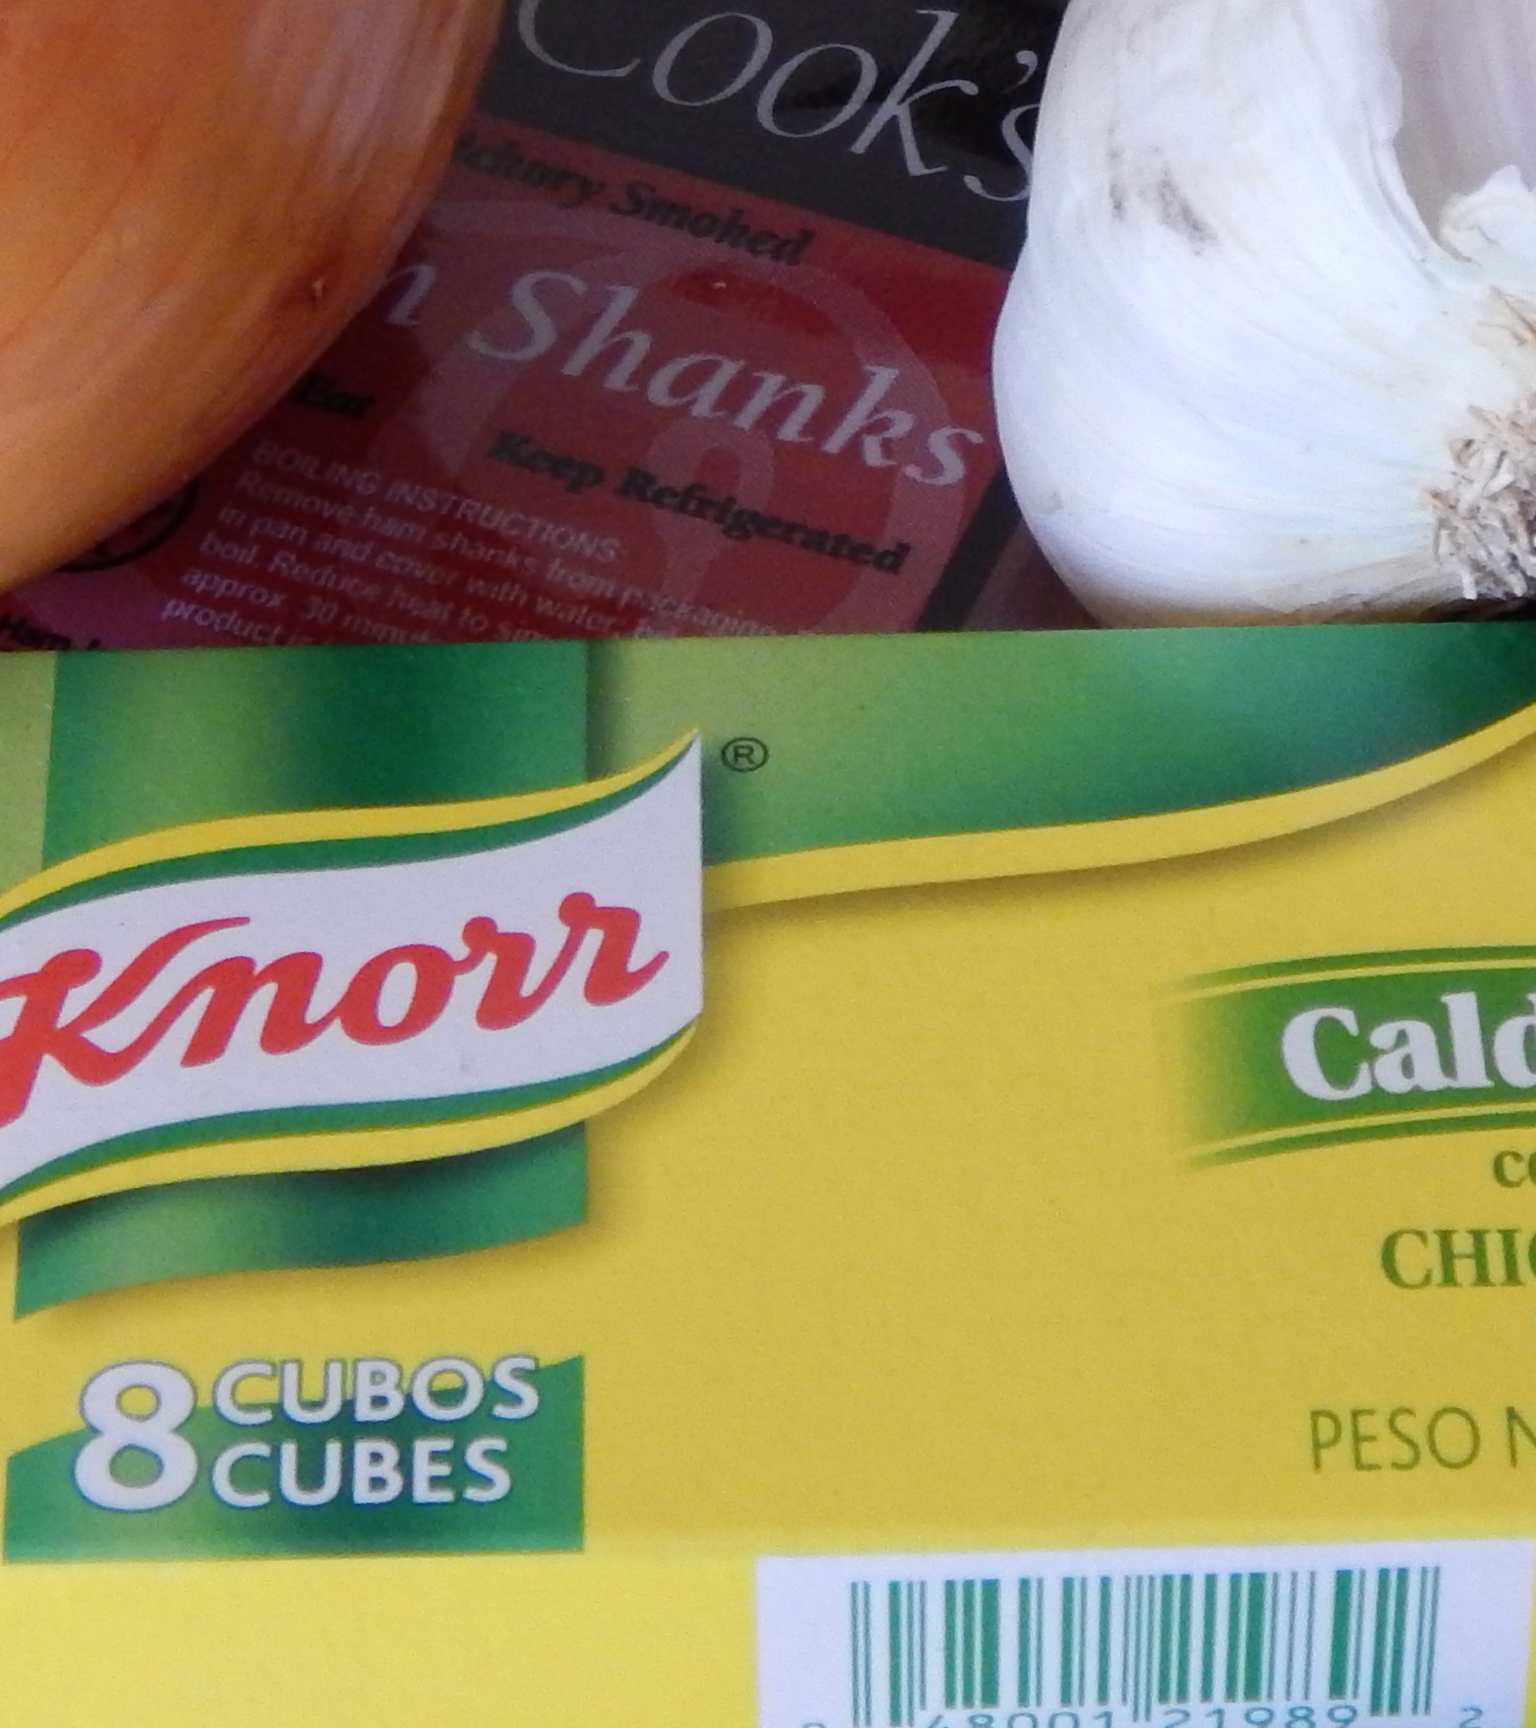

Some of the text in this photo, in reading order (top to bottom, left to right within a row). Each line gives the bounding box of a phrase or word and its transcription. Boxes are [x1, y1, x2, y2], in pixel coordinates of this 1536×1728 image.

[609, 181, 815, 266] Smoked
[465, 271, 984, 487] Shanks
[254, 440, 380, 495] BOILING
[486, 431, 911, 576] Keep Refrigerated
[217, 507, 247, 526] in
[249, 516, 308, 546] pan
[315, 532, 374, 562] and
[375, 551, 460, 585] cover
[467, 578, 527, 607] with
[235, 471, 357, 522] Remove
[364, 507, 426, 539] ham
[431, 531, 539, 574] shanks
[161, 598, 284, 646] product
[268, 551, 382, 603] Reduce
[386, 586, 455, 622] heat
[458, 608, 488, 633] to
[73, 1354, 542, 1512] 8 CUBOS
[211, 1435, 514, 1510] CUBES
[1308, 1404, 1481, 1472] PESO
